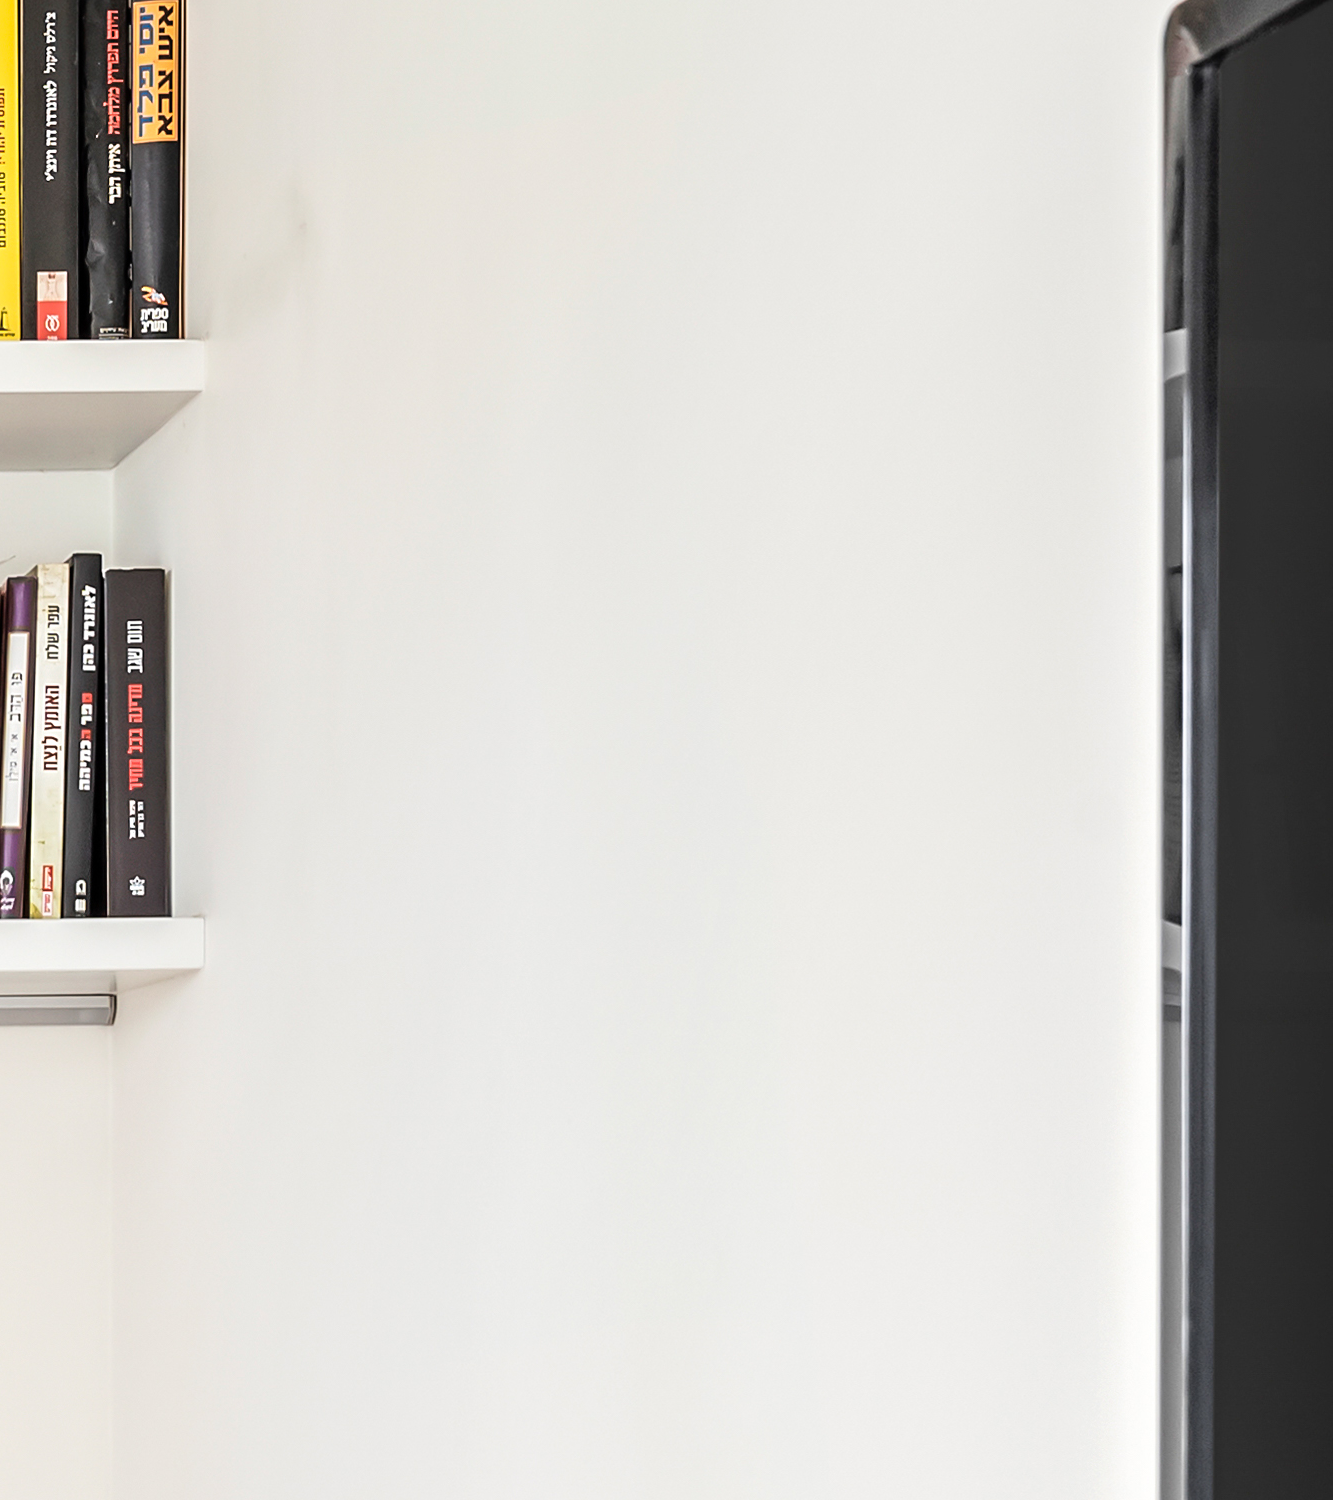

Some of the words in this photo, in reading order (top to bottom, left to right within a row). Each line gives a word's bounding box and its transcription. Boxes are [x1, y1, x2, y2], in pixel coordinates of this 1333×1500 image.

[107, 10, 119, 39] היום
[139, 7, 153, 54] יוסי
[159, 6, 173, 60] איש
[107, 43, 124, 84] תפרוץ
[103, 87, 120, 134] מלחמה
[137, 65, 154, 137] פלד
[158, 71, 173, 135] צבא
[108, 144, 125, 173] איתן
[109, 177, 121, 204] הבר
[82, 585, 96, 640] לאונרד
[127, 621, 142, 643] תום
[83, 644, 96, 671] כהן
[128, 648, 143, 673] שגב
[81, 693, 92, 725] ספר
[128, 684, 143, 722] מדינה
[127, 728, 143, 754] בכל
[79, 730, 91, 790] הכמיהה
[129, 759, 143, 790] מחיר
